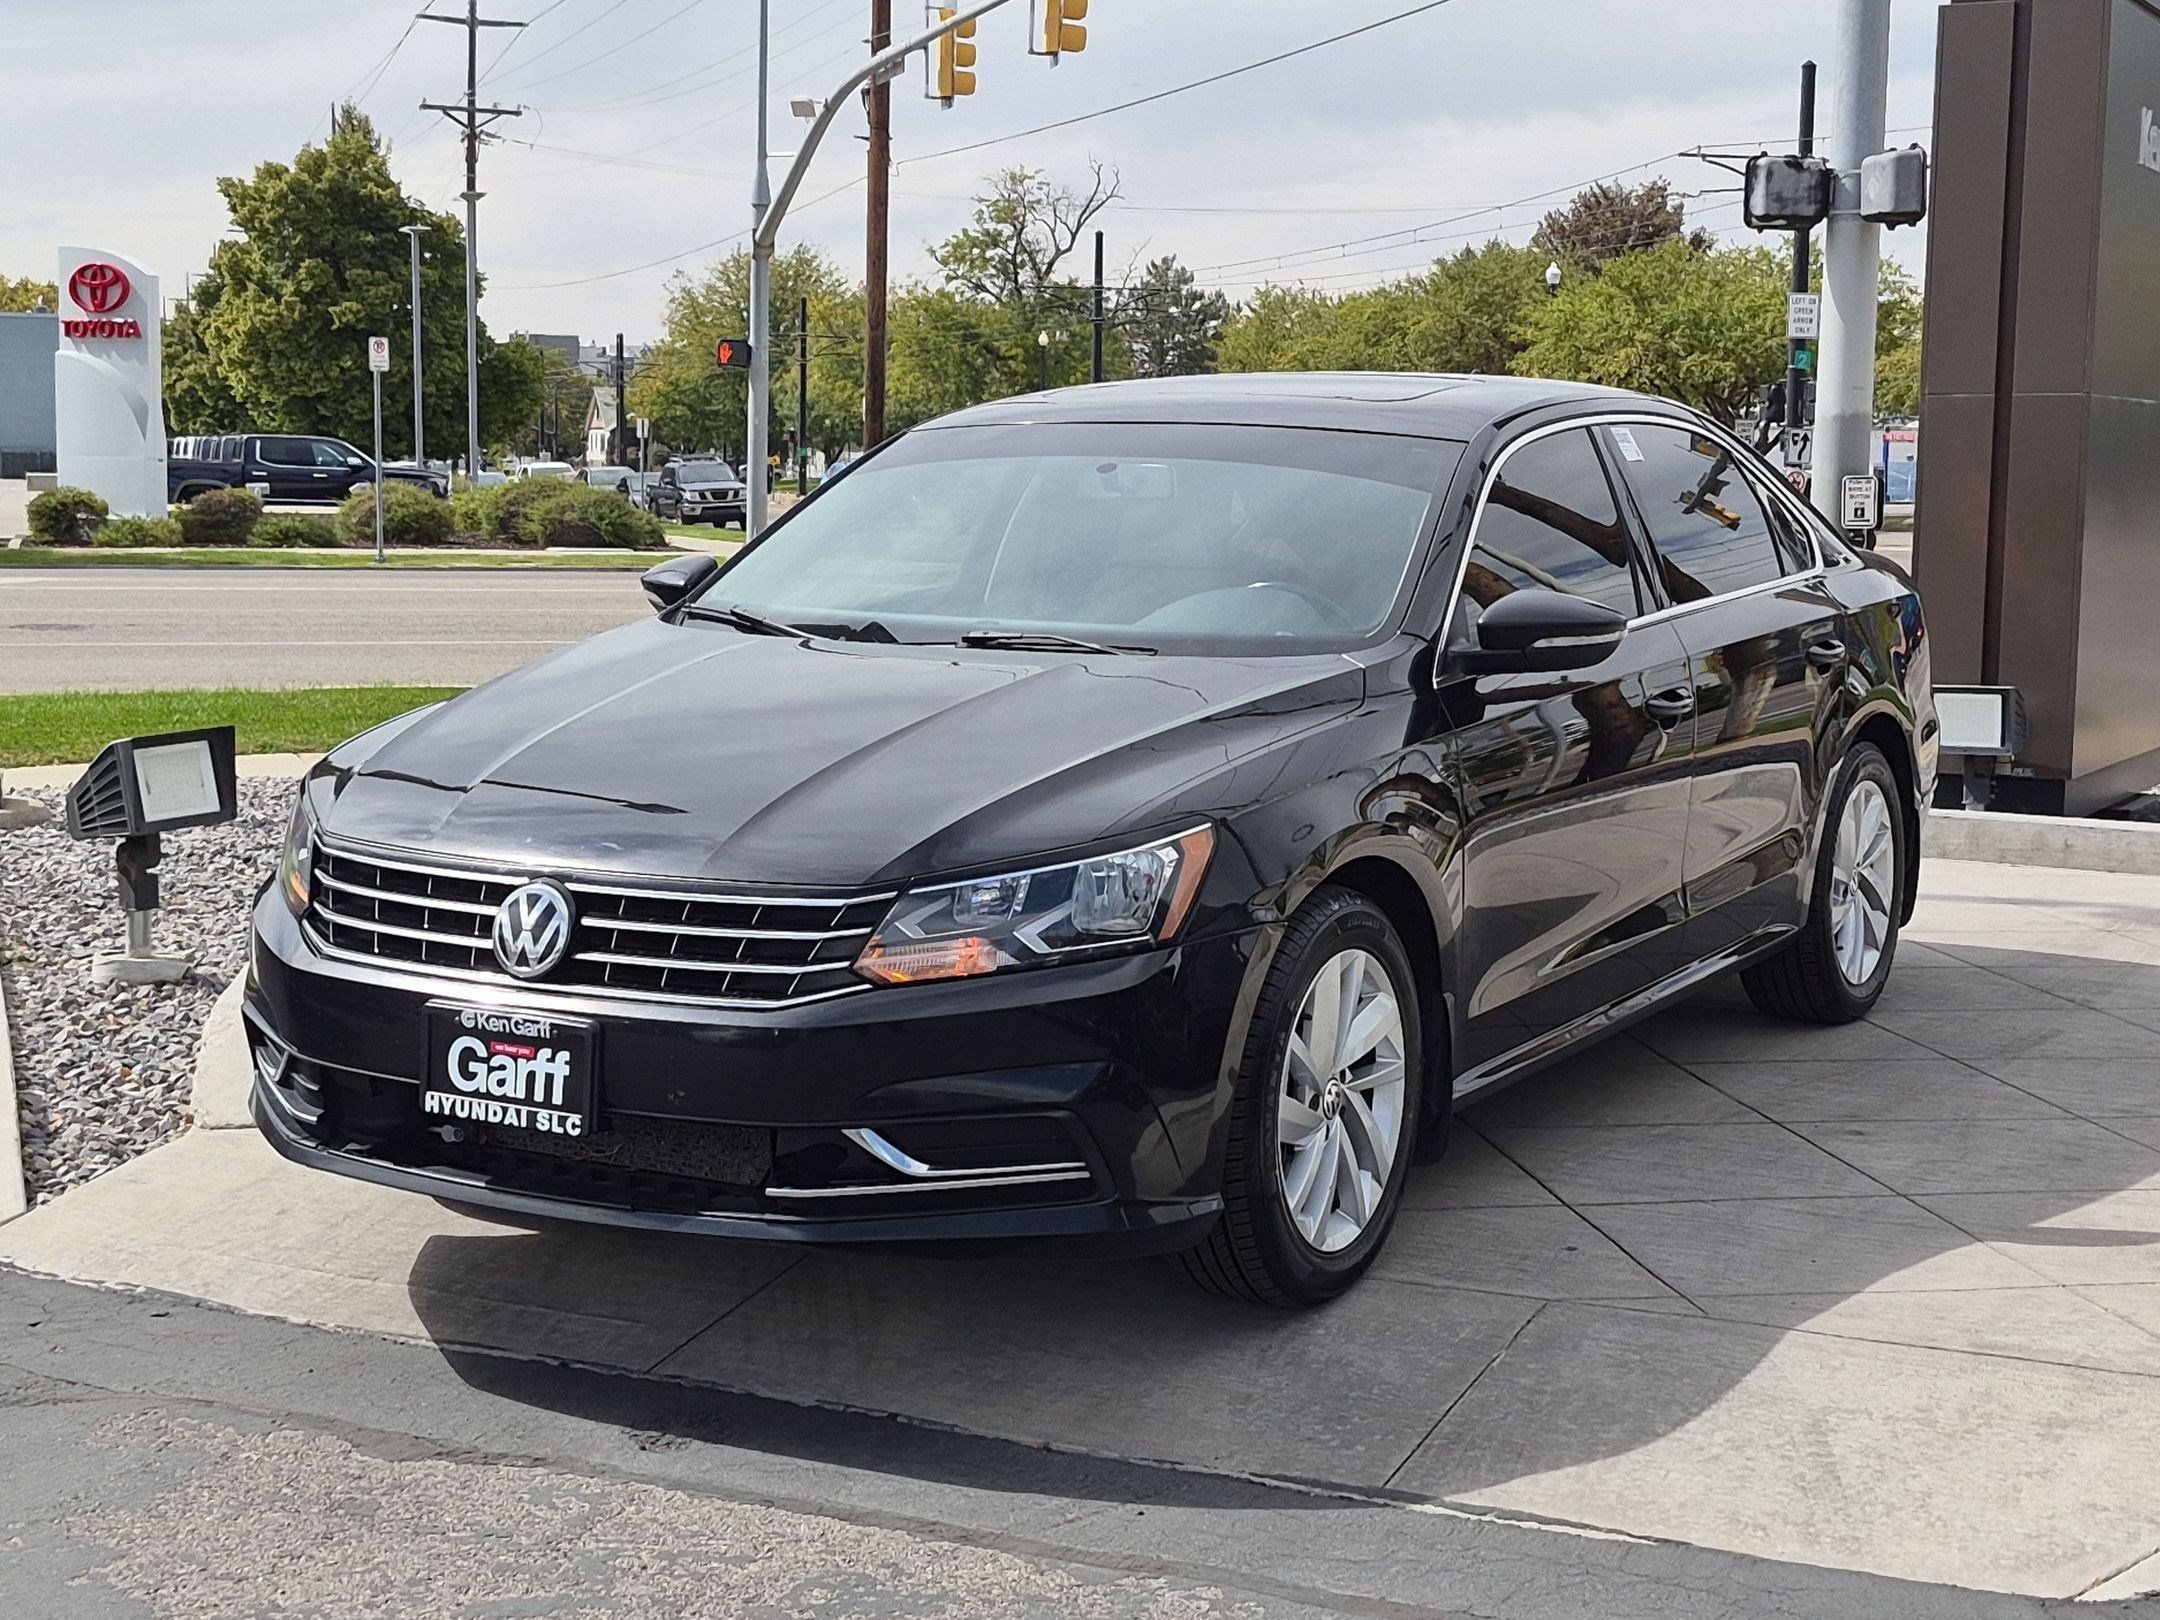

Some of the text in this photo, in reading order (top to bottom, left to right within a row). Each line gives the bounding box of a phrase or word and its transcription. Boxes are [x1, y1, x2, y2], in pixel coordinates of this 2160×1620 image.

[1791, 297, 1805, 305] LEFT
[1794, 307, 1813, 315] GREEN
[61, 319, 142, 339] TOYOTA
[1795, 326, 1810, 334] ONLY
[1798, 353, 1808, 368] 2
[477, 1013, 551, 1039] Ken Garff
[447, 1035, 571, 1106] Garff
[424, 1092, 582, 1137] HYUNDAI SLC
